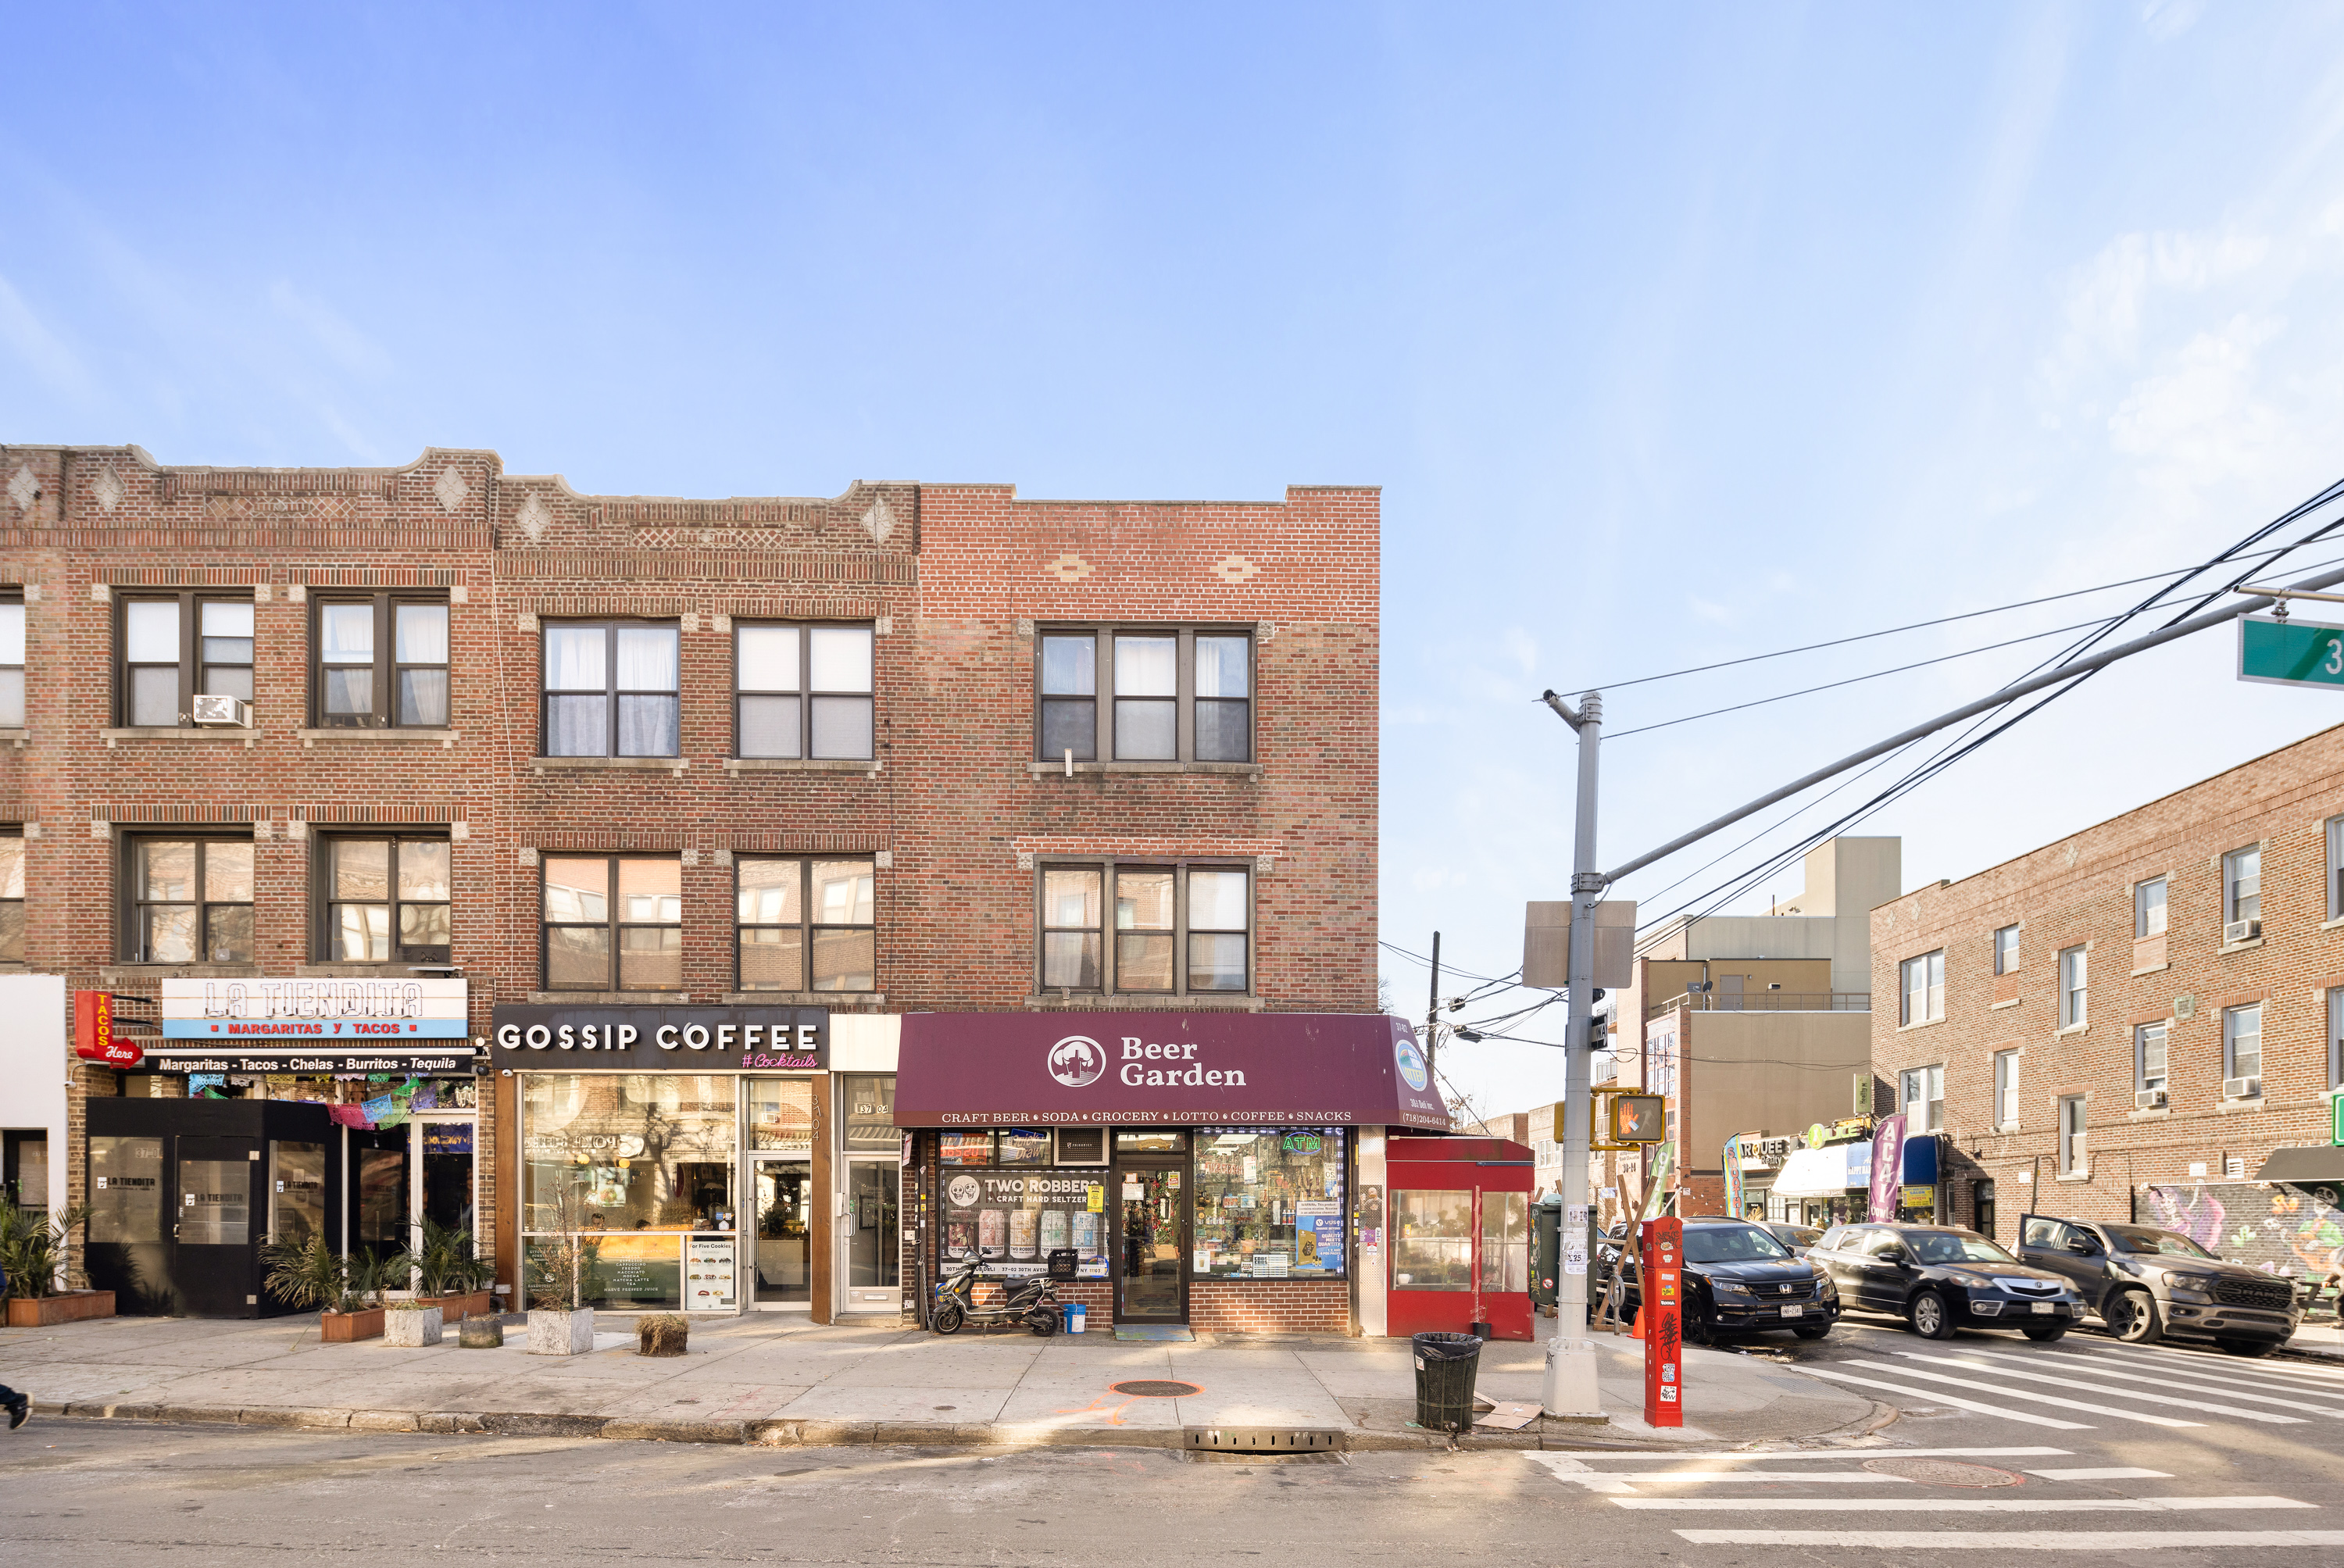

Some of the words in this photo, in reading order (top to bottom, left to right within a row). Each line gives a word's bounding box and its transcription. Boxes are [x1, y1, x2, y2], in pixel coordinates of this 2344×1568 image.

[204, 983, 247, 1017] LA
[259, 983, 423, 1017] TIENDITA
[97, 995, 109, 1046] TACOS
[228, 1023, 322, 1034] MARGARITAS
[352, 1023, 399, 1034] TACOS
[498, 1024, 638, 1050] GOSSIP
[656, 1022, 816, 1050] COFFEE
[1595, 1023, 1608, 1039] WA
[105, 1046, 133, 1059] Here
[1120, 1037, 1198, 1059] Beer
[159, 1059, 228, 1073] Margaritas
[240, 1059, 278, 1070] Tacos
[290, 1059, 334, 1070] Chelas
[346, 1058, 398, 1070] Burritos
[410, 1058, 456, 1071] Tequila
[742, 1052, 818, 1068] #Cocktails
[1120, 1062, 1246, 1087] Garden
[1402, 1066, 1424, 1083] LOTTERY
[860, 1105, 871, 1113] 37
[942, 1113, 989, 1123] CRAFT
[993, 1113, 1030, 1123] BEER
[1042, 1112, 1080, 1122] SODA
[1092, 1112, 1159, 1122] GROCERY
[1172, 1112, 1219, 1121] LOTTO
[1231, 1112, 1285, 1121] COFFEE
[1296, 1112, 1352, 1121] SNACKS
[1402, 1112, 1446, 1126] (718)204-6414
[1823, 1124, 1860, 1141] JUICE
[1282, 1137, 1320, 1150] ATM
[1741, 1140, 1782, 1156] ARQUEE
[1761, 1155, 1781, 1166] Realty
[1879, 1121, 1896, 1203] ACAI
[120, 1177, 155, 1186] TIENDITA
[984, 1179, 1024, 1192] TWO
[2242, 1289, 2274, 1298] RAM
